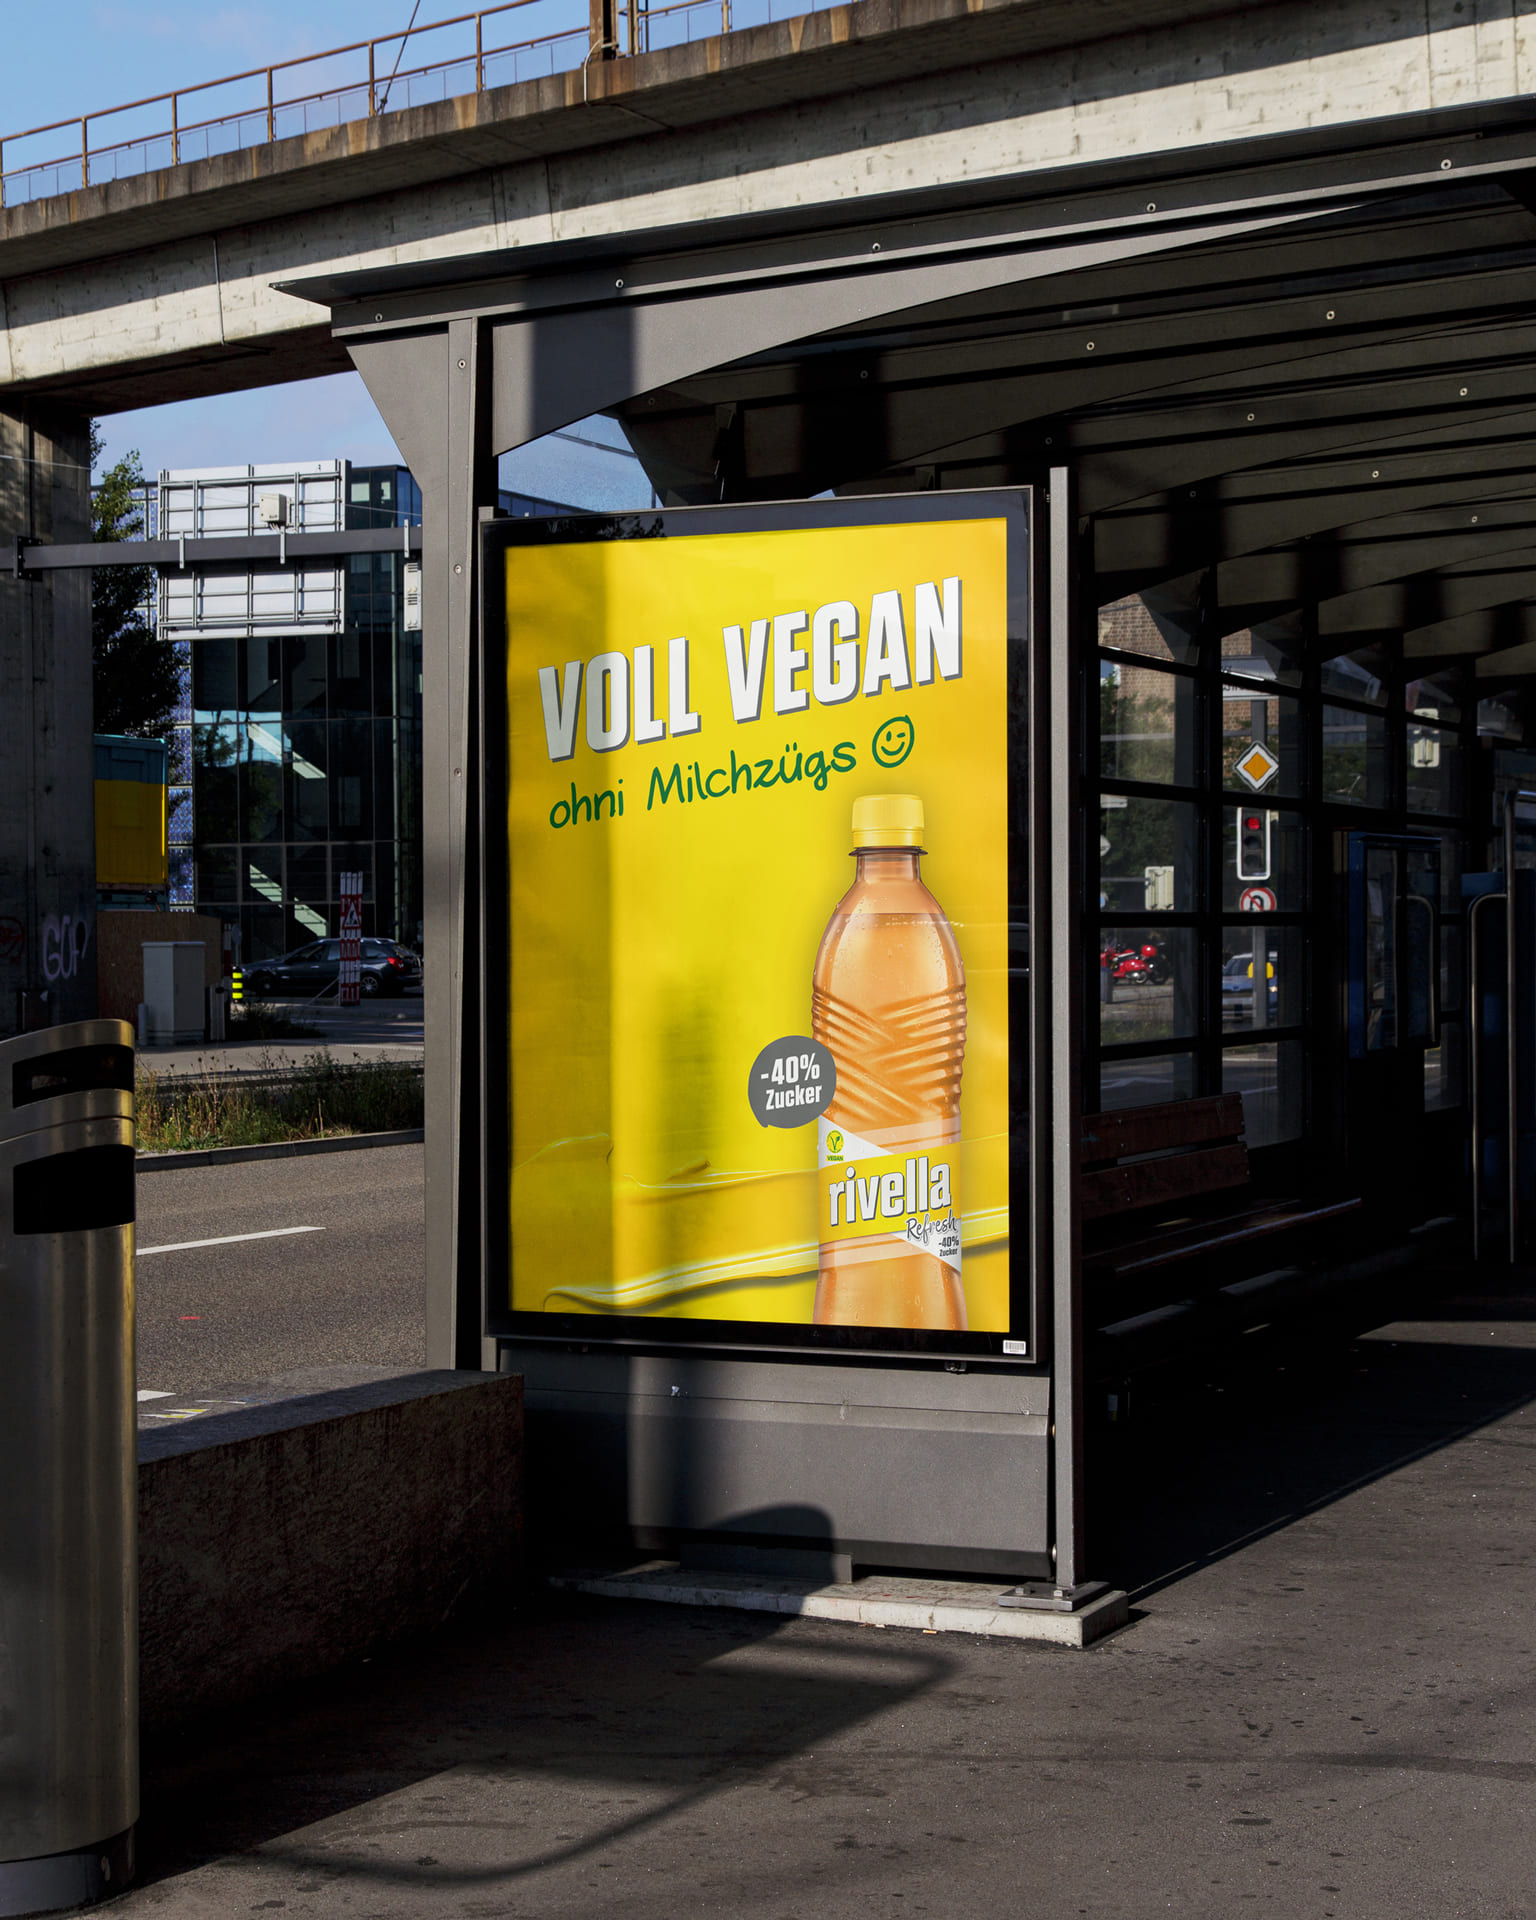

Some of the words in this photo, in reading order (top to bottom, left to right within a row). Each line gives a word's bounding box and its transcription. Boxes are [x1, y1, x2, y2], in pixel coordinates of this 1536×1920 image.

[538, 636, 701, 763] VOLL
[722, 576, 963, 723] VEGAN
[549, 778, 624, 830] ohni
[646, 740, 857, 811] Milchzügs
[760, 1052, 820, 1085] -40%
[765, 1083, 823, 1111] Zucker
[829, 1156, 952, 1227] rivella
[906, 1208, 957, 1244] Refresh
[939, 1235, 960, 1247] -40%
[939, 1248, 958, 1257] Zucker
